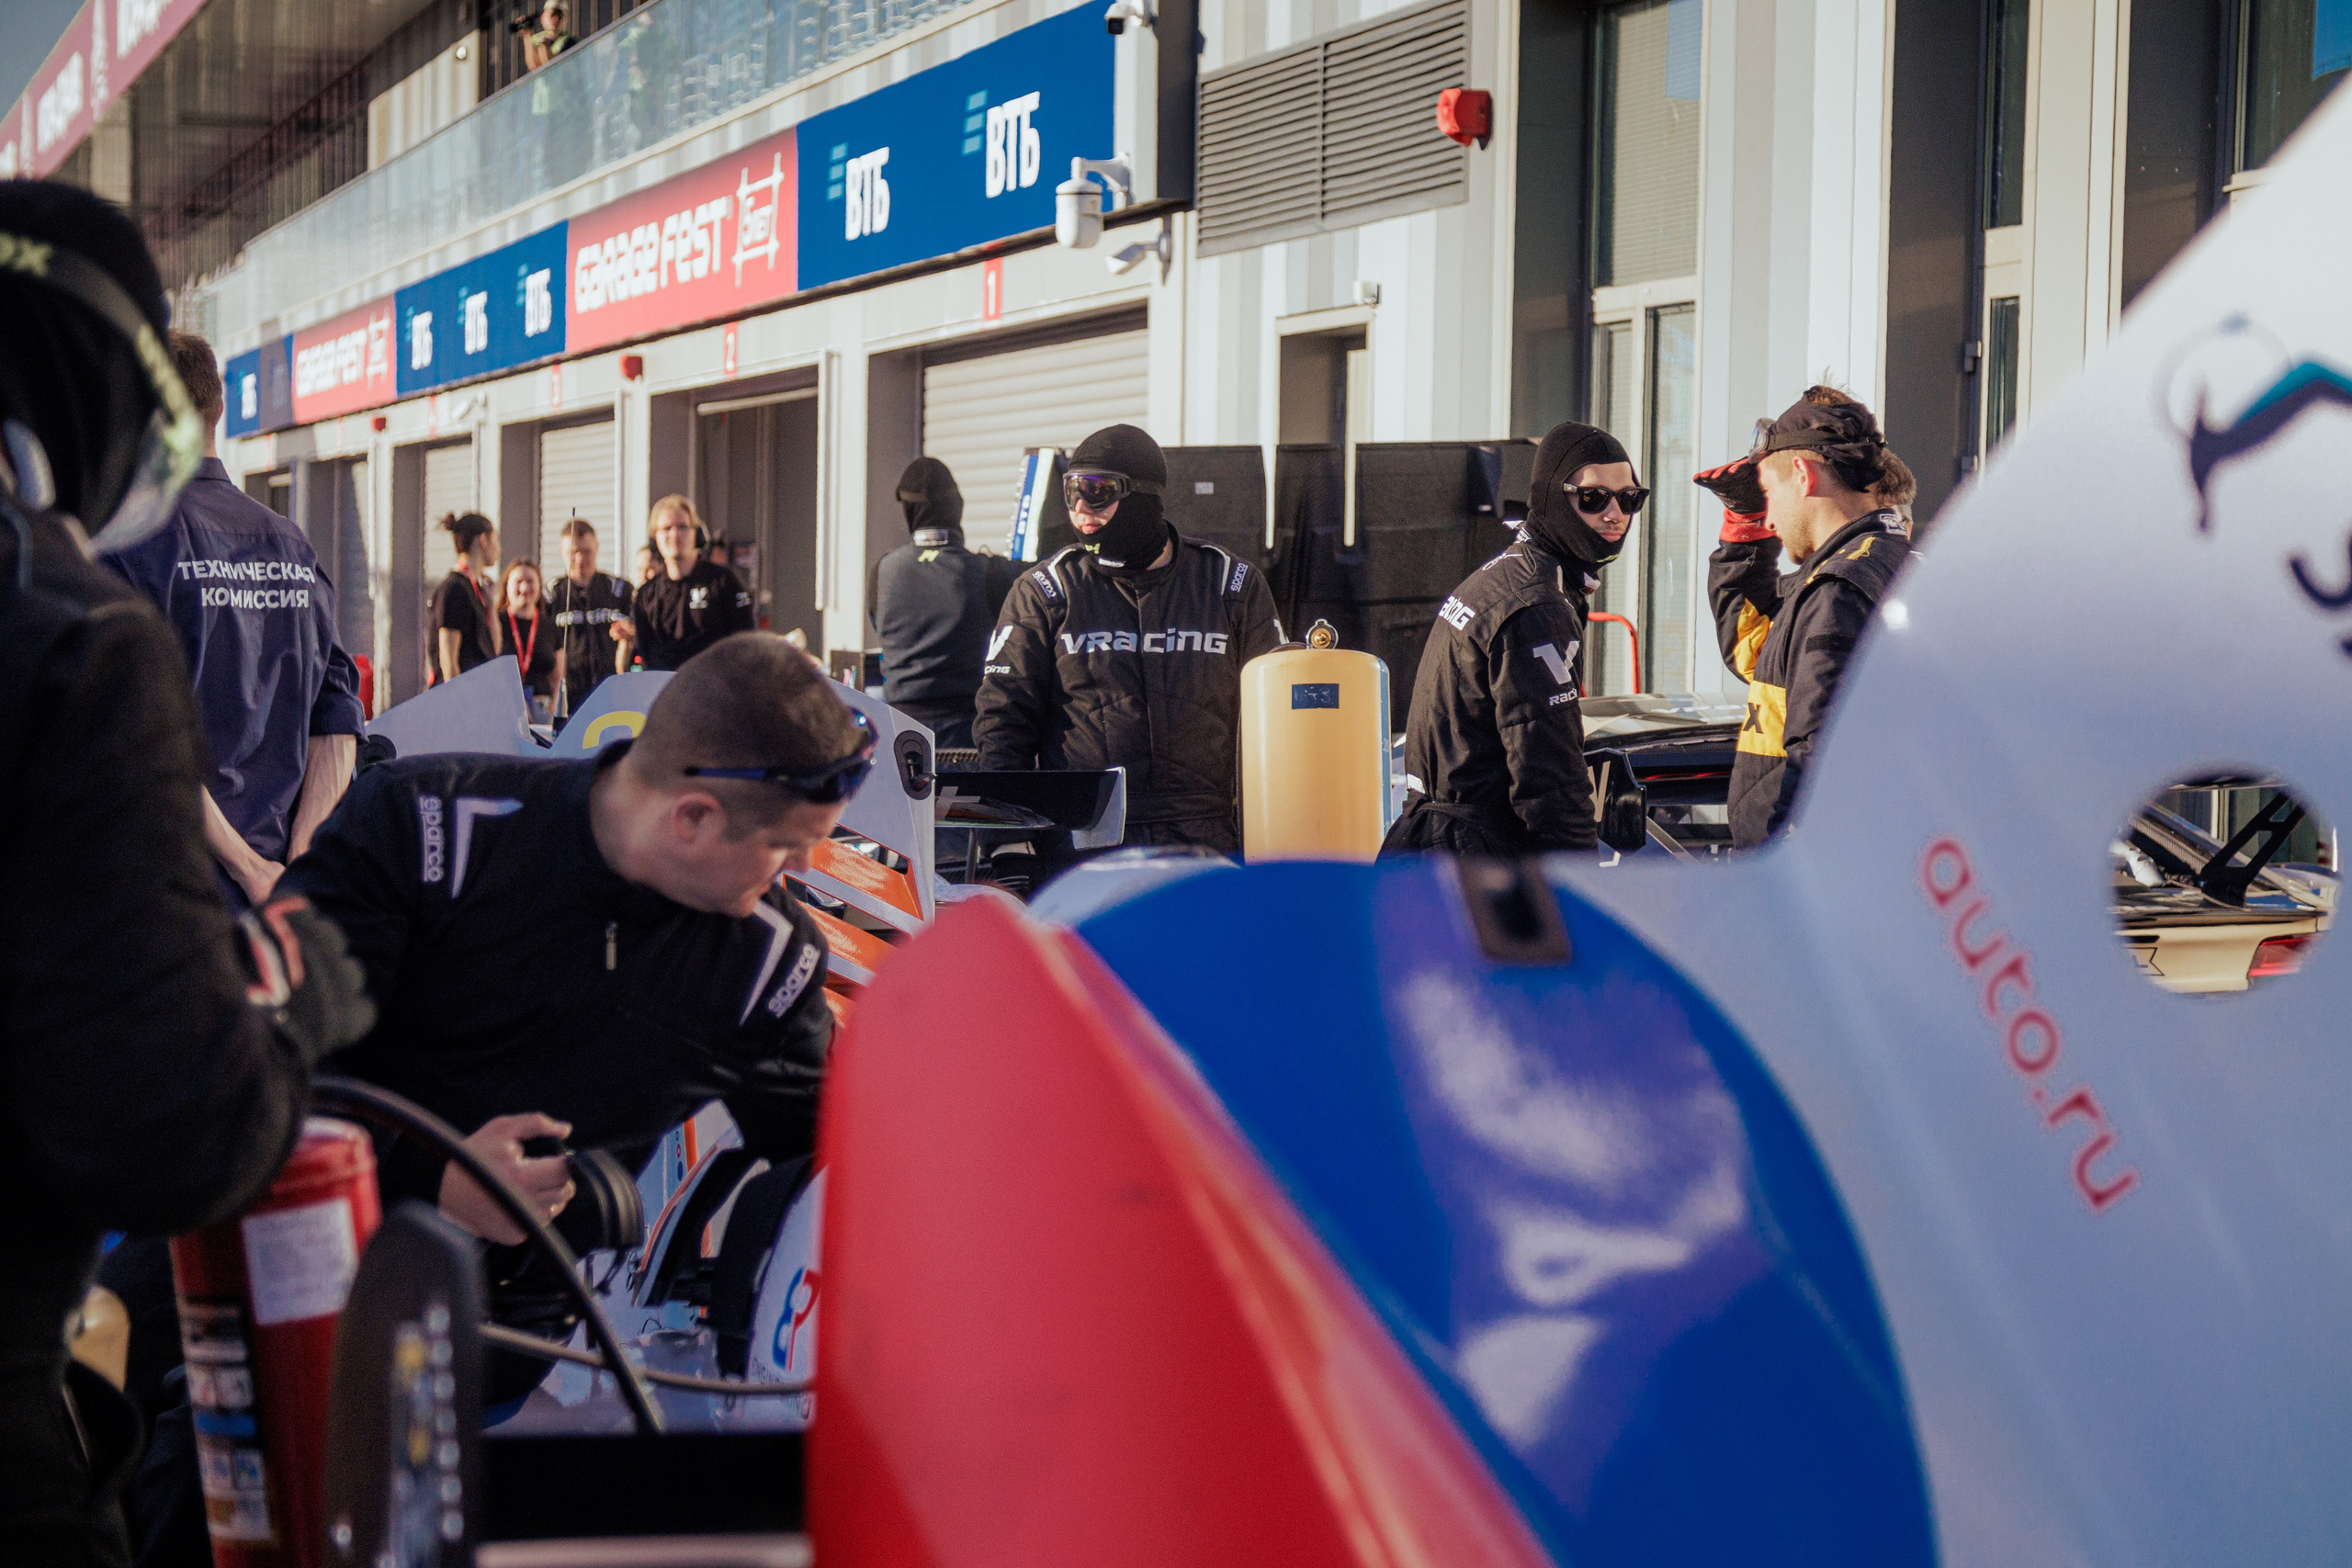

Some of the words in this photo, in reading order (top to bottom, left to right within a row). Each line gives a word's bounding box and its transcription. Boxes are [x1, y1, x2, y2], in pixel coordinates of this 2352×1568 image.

[986, 91, 1041, 199] ВТБ
[845, 146, 890, 242] ВТБ
[988, 270, 995, 317] 1
[178, 559, 316, 583] ТЕХНИЧЕСКАЯ
[201, 587, 310, 610] КОМИССИЯ
[419, 795, 446, 883] sparco
[768, 942, 821, 1020] sparco
[1923, 839, 2139, 1211] auto.ru
